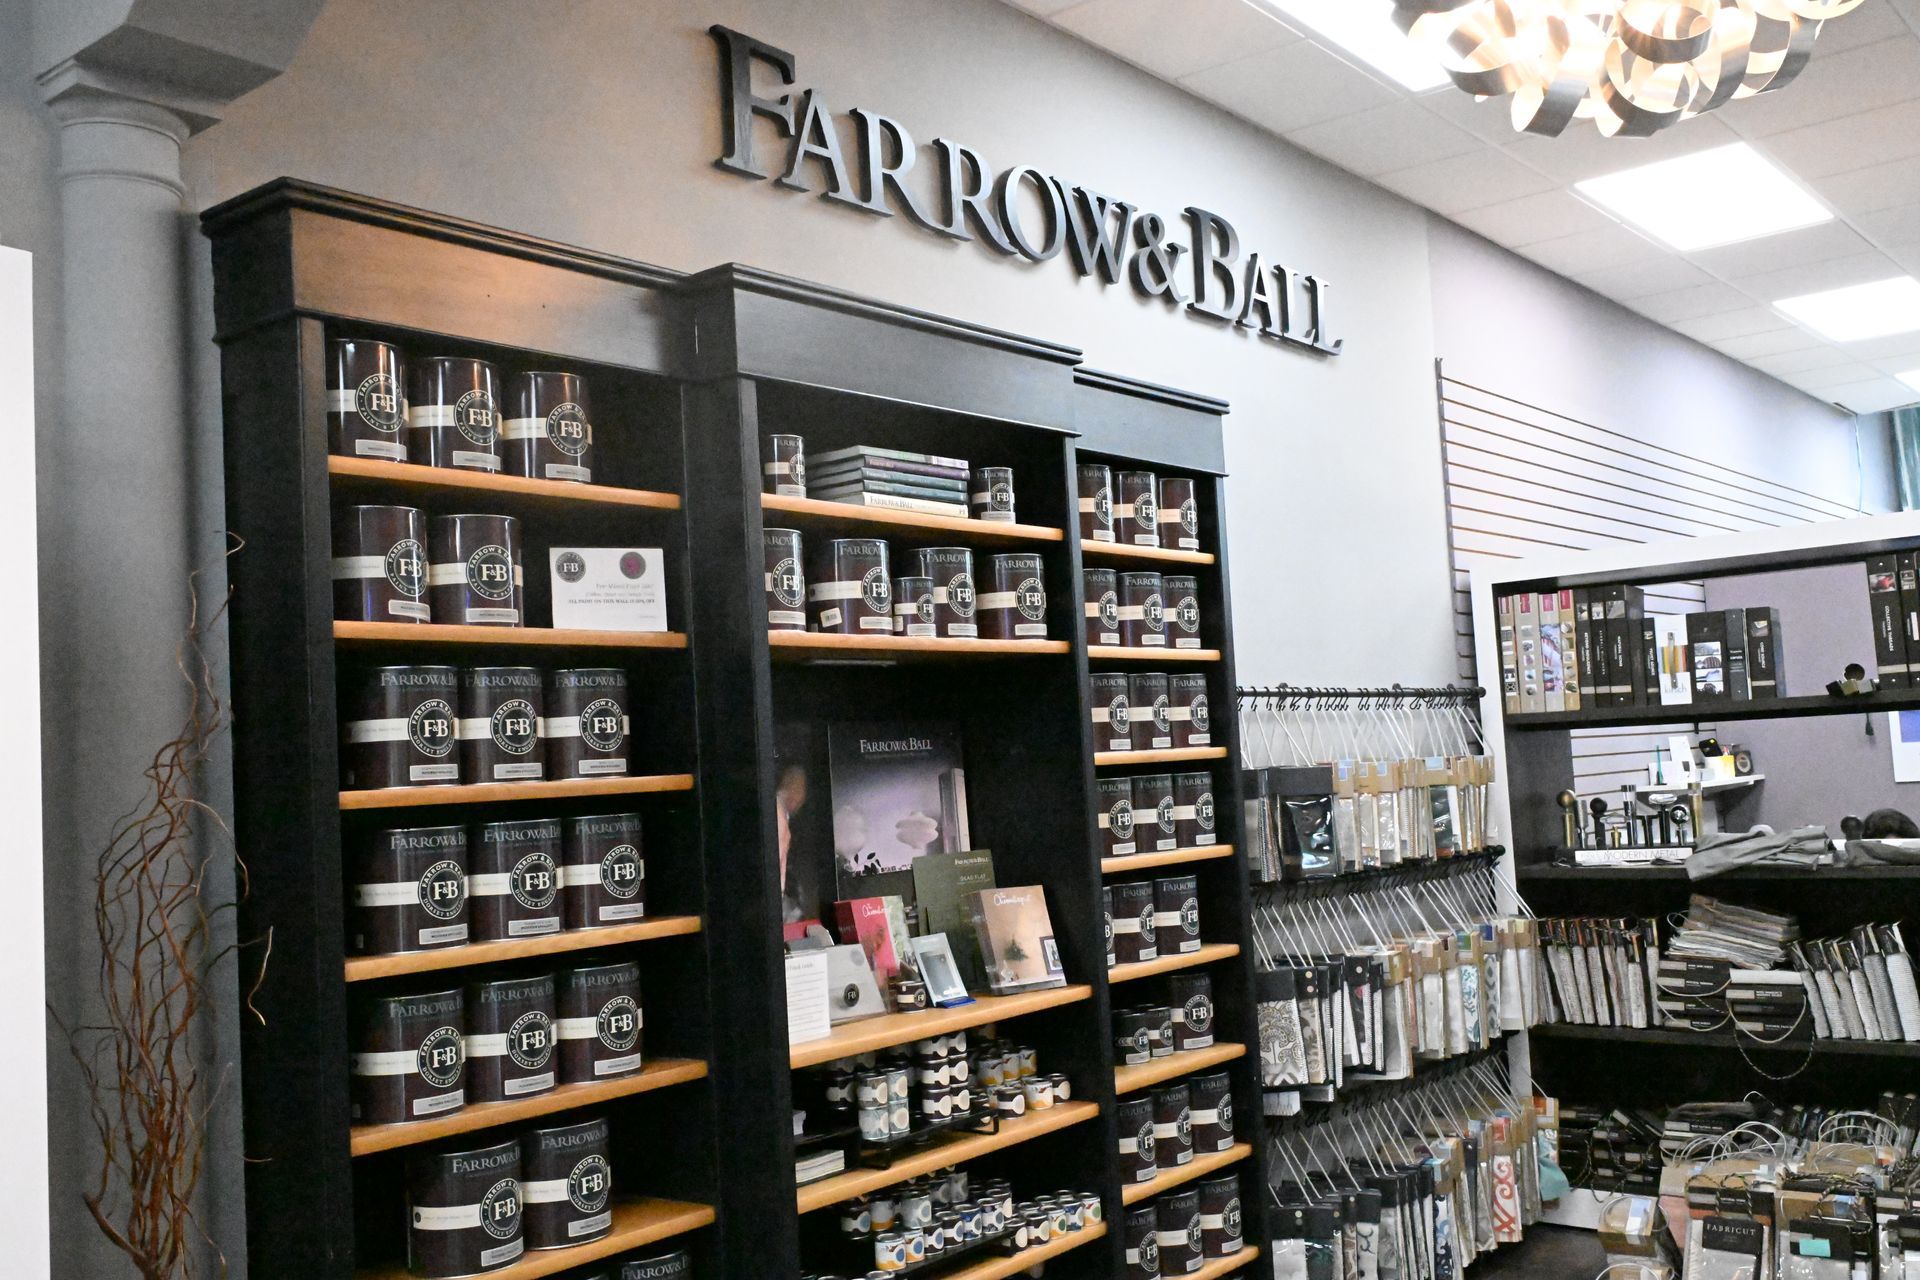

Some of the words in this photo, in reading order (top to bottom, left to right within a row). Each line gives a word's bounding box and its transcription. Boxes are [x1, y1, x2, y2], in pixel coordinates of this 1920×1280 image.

[468, 408, 492, 427] F&B
[560, 420, 582, 438] F&B
[481, 564, 508, 581] F&B
[411, 702, 438, 724] FARROW
[494, 702, 519, 723] FARROW
[582, 701, 606, 722] FARROW
[423, 719, 448, 737] F&B
[505, 718, 531, 735] F&B
[593, 717, 617, 733] F&B
[514, 855, 538, 878] FARROW
[604, 847, 626, 870] FARROW
[422, 863, 448, 888] FARROW
[524, 871, 550, 891] F&B
[613, 862, 635, 880] F&B
[433, 881, 458, 900] F&B
[600, 998, 623, 1022] FARROW
[1192, 1007, 1207, 1020] F&B
[510, 1014, 535, 1039] FARROW
[610, 1014, 632, 1034] F&B
[421, 1029, 446, 1056] FARROW
[521, 1030, 545, 1051] F&B
[432, 1046, 456, 1068] F&B
[570, 1157, 593, 1184] FARROW
[483, 1180, 507, 1209] FARROW
[581, 1173, 603, 1195] F&B
[494, 1197, 516, 1220] F&B
[1707, 1224, 1756, 1235] FABRICUT
